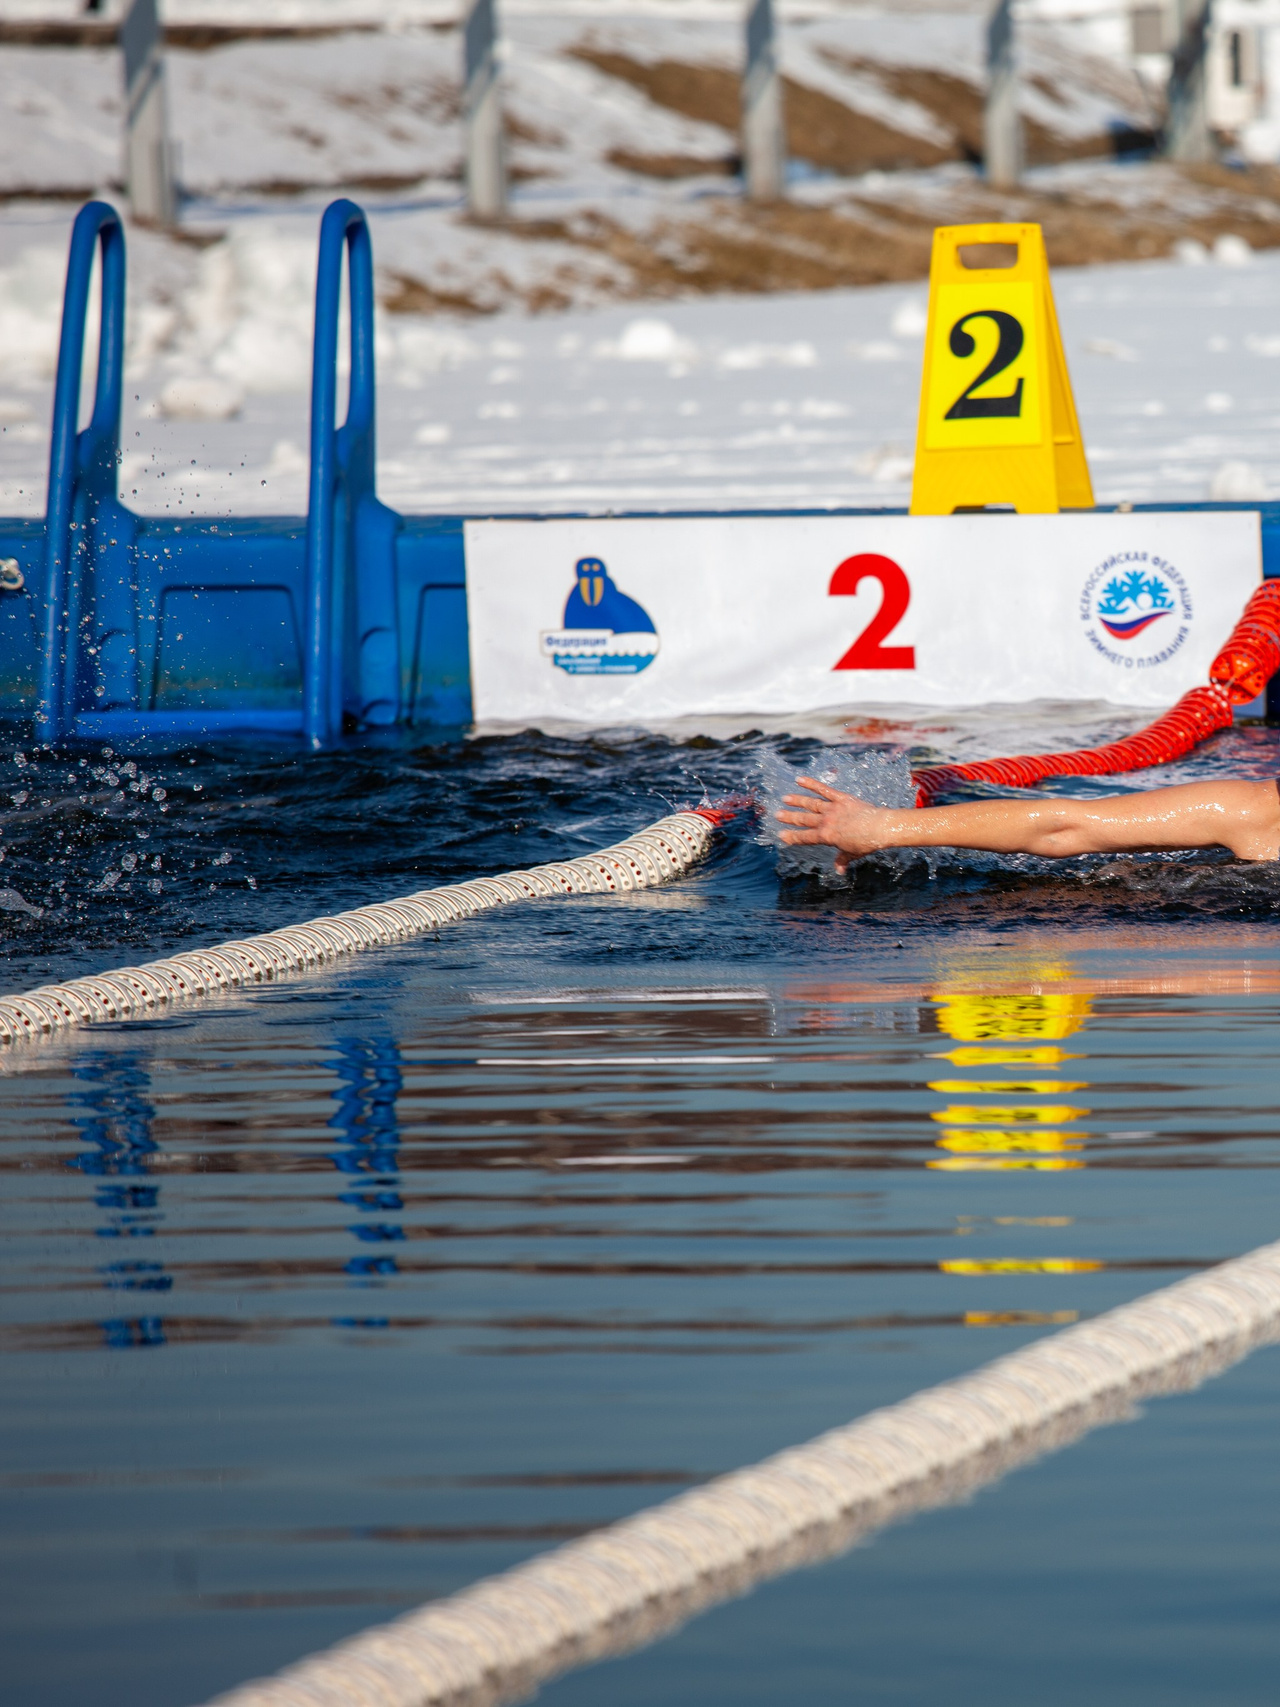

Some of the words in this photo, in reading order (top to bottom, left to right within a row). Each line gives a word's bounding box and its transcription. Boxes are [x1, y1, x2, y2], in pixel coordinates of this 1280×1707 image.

[944, 310, 1024, 421] 2
[829, 553, 914, 670] 2
[1080, 552, 1149, 621] ВСЕРОССИЙСКАЯ
[1151, 556, 1193, 620] ФЕДЕРАЦИЯ
[545, 636, 607, 648] Федерация
[1085, 629, 1134, 669] ЗИМНЕГО
[1136, 626, 1190, 669] ПЛАВАНИЯ
